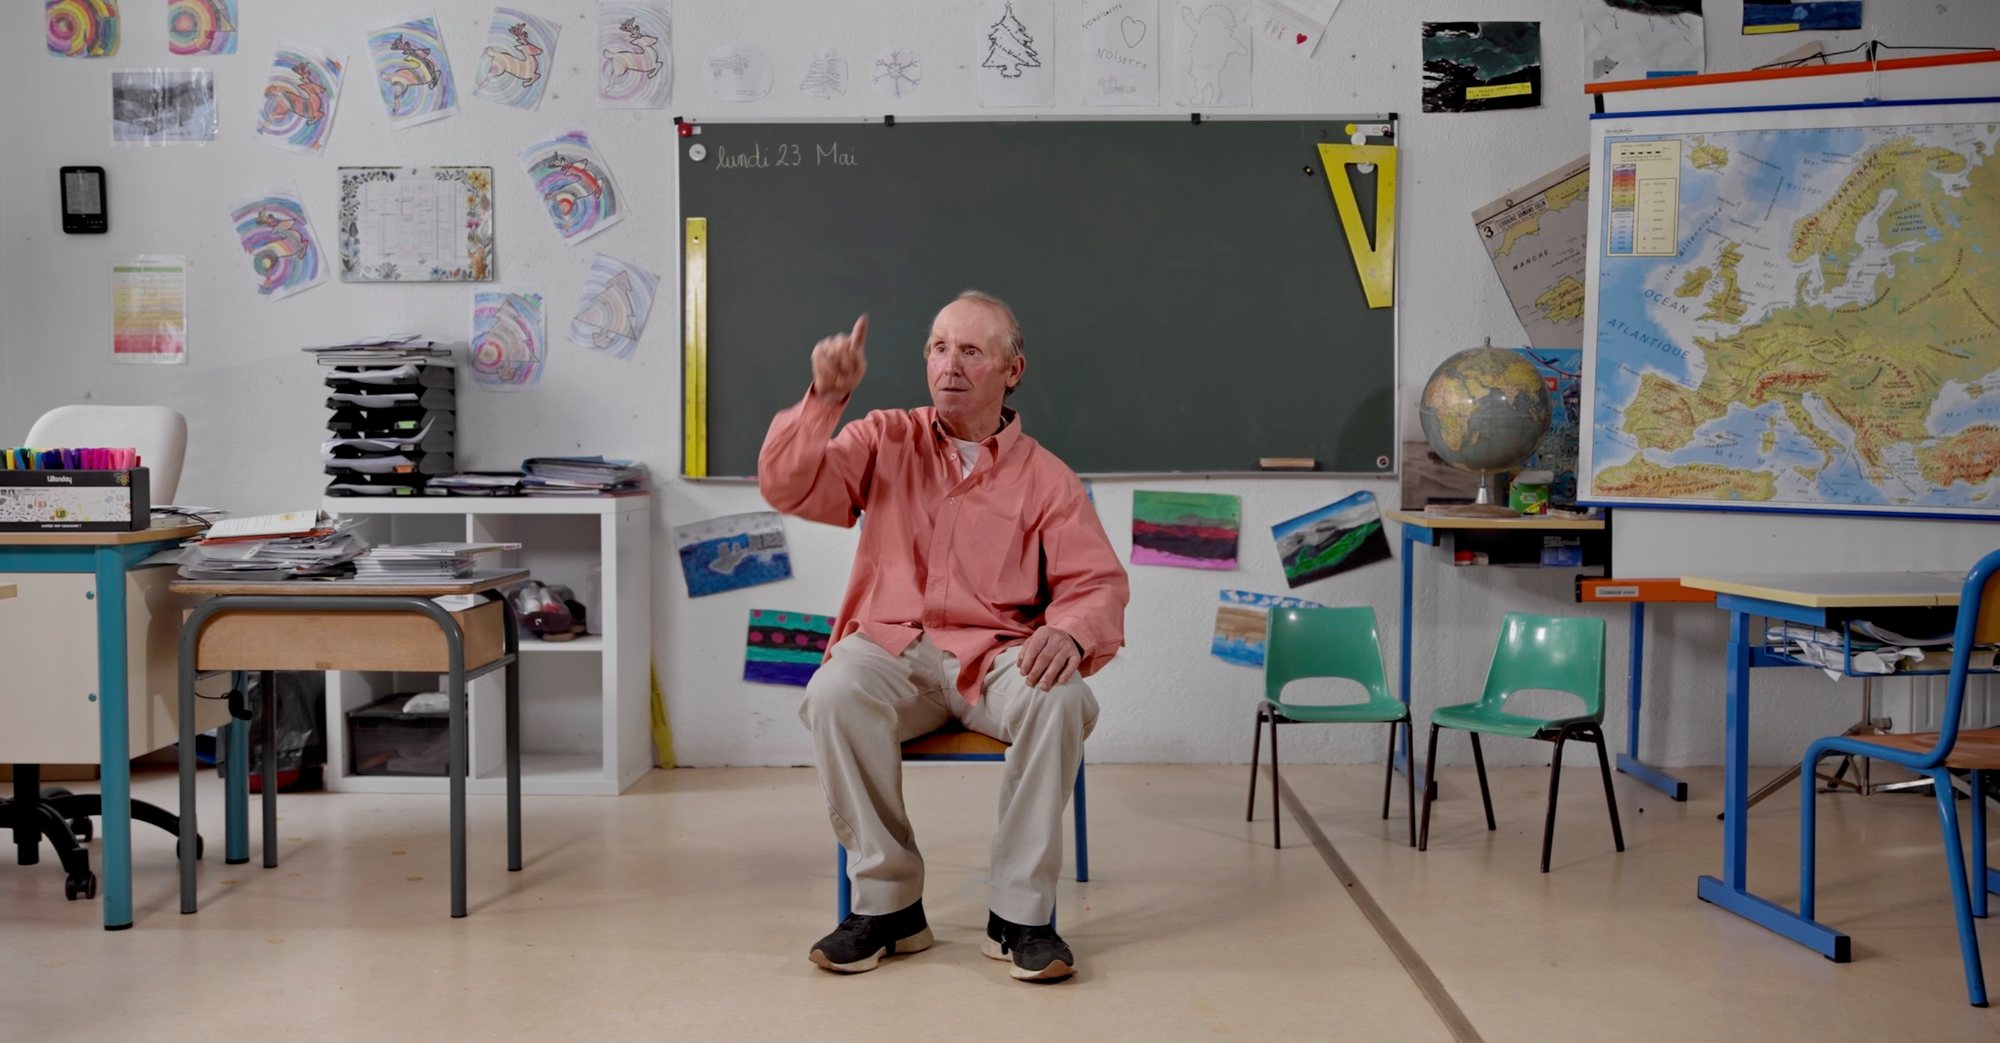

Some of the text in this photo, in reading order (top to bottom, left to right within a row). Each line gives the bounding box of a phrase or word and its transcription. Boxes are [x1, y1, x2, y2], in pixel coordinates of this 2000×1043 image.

[715, 142, 859, 171] lundi 23 Mai
[1483, 225, 1495, 240] 3
[1512, 249, 1550, 272] MANCHE
[1607, 317, 1691, 361] ATLANTIQUE
